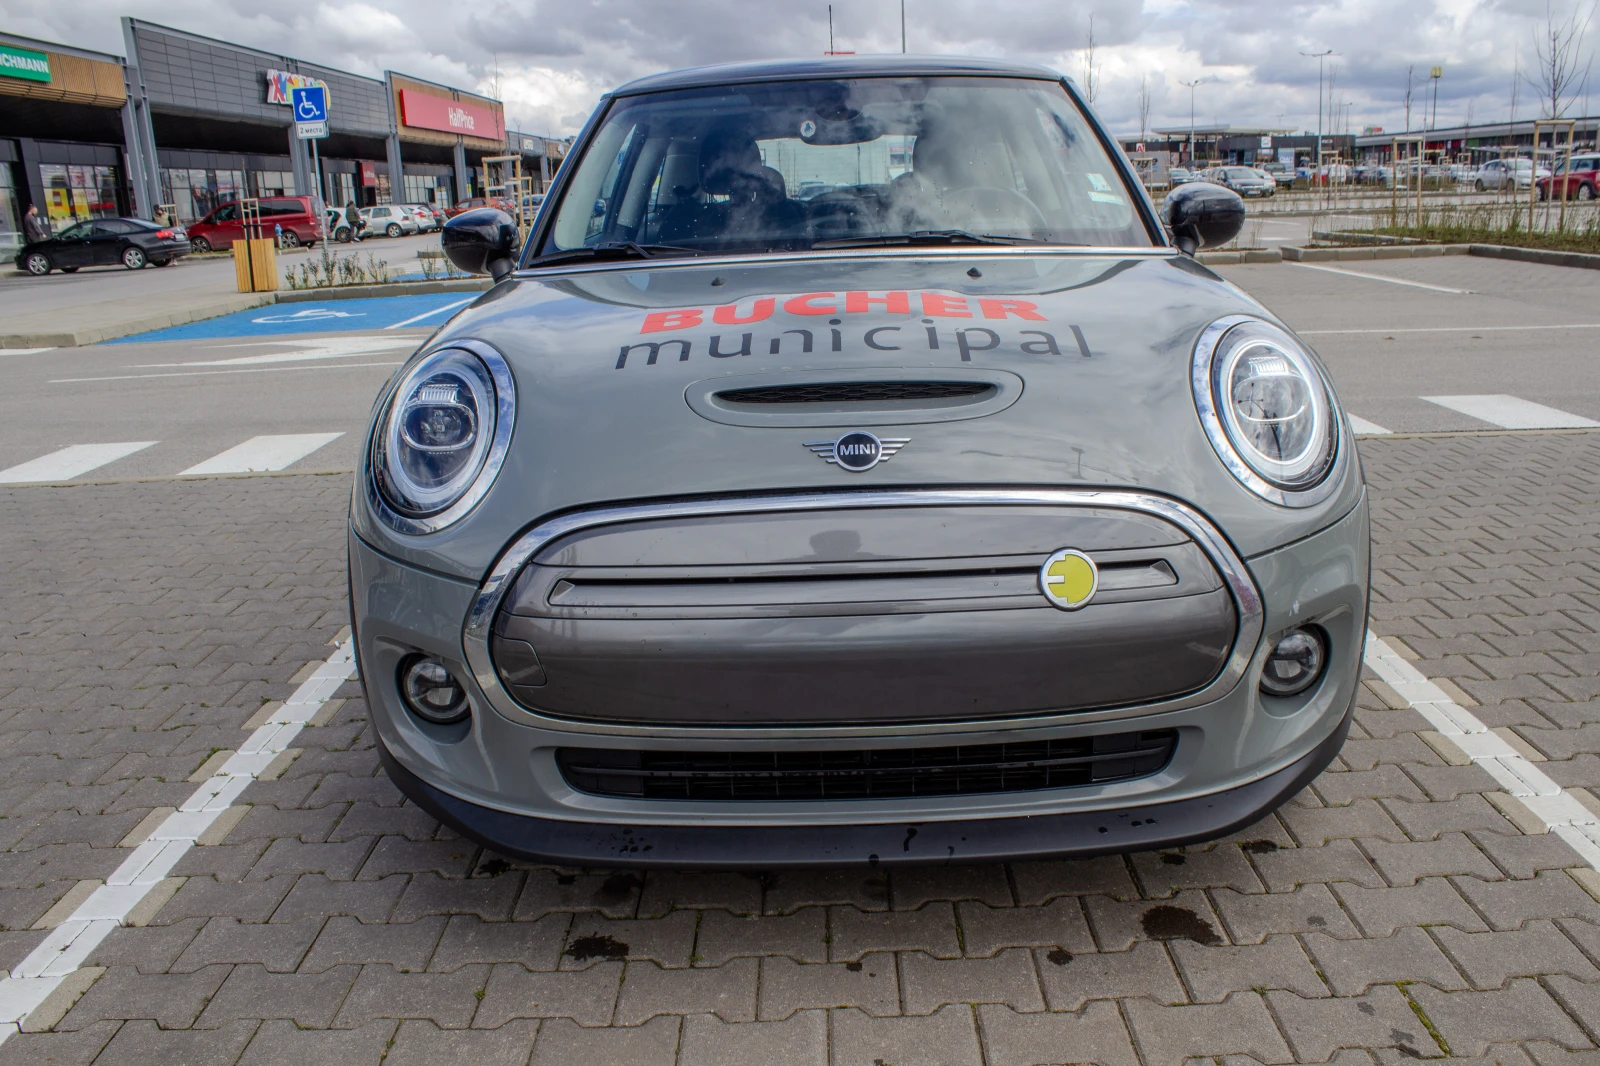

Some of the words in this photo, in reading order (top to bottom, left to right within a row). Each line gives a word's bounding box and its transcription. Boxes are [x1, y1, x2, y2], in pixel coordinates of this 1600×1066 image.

[448, 107, 475, 130] HalfPrice
[639, 291, 1049, 334] BUCHER
[615, 318, 1092, 369] municipal
[840, 443, 876, 456] MINI
